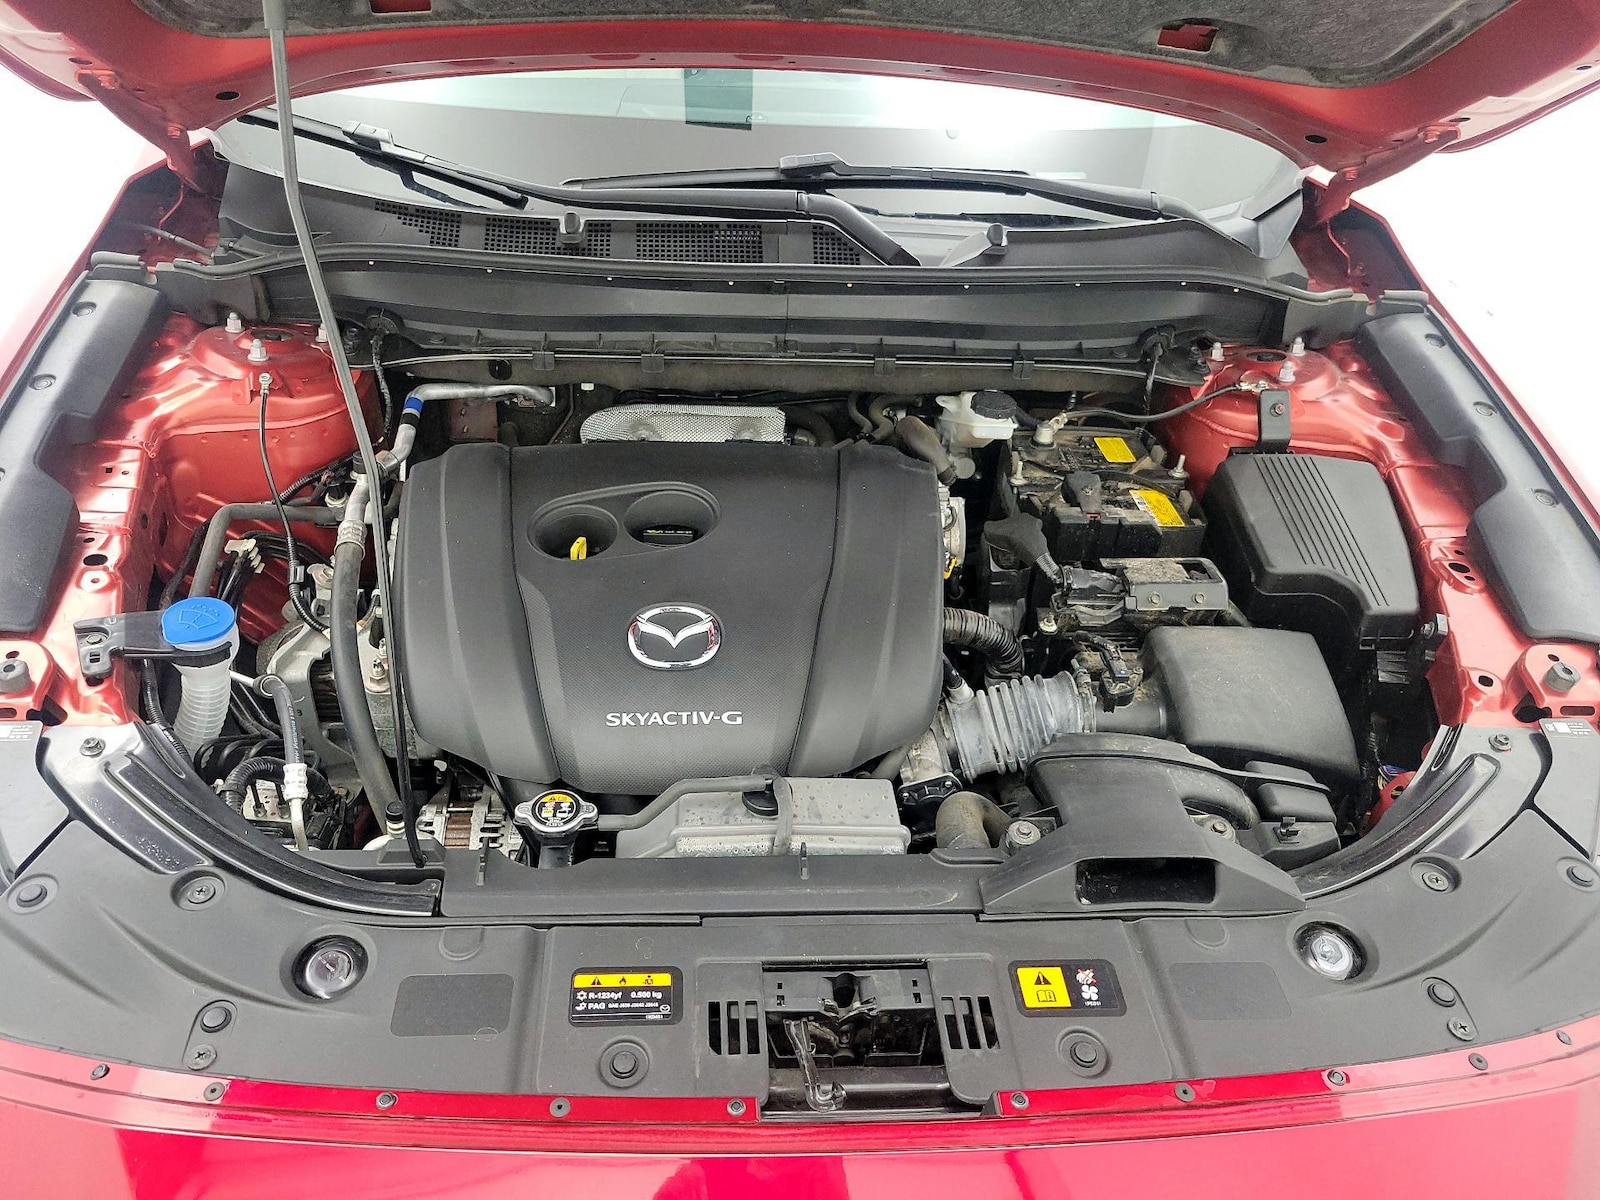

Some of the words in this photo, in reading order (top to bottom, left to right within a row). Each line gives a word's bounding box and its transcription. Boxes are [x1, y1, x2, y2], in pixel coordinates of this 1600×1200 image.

[605, 711, 743, 727] SKYACTIV-G
[588, 991, 622, 1000] R-1234yf
[652, 991, 662, 999] kg
[588, 1002, 605, 1010] PAG
